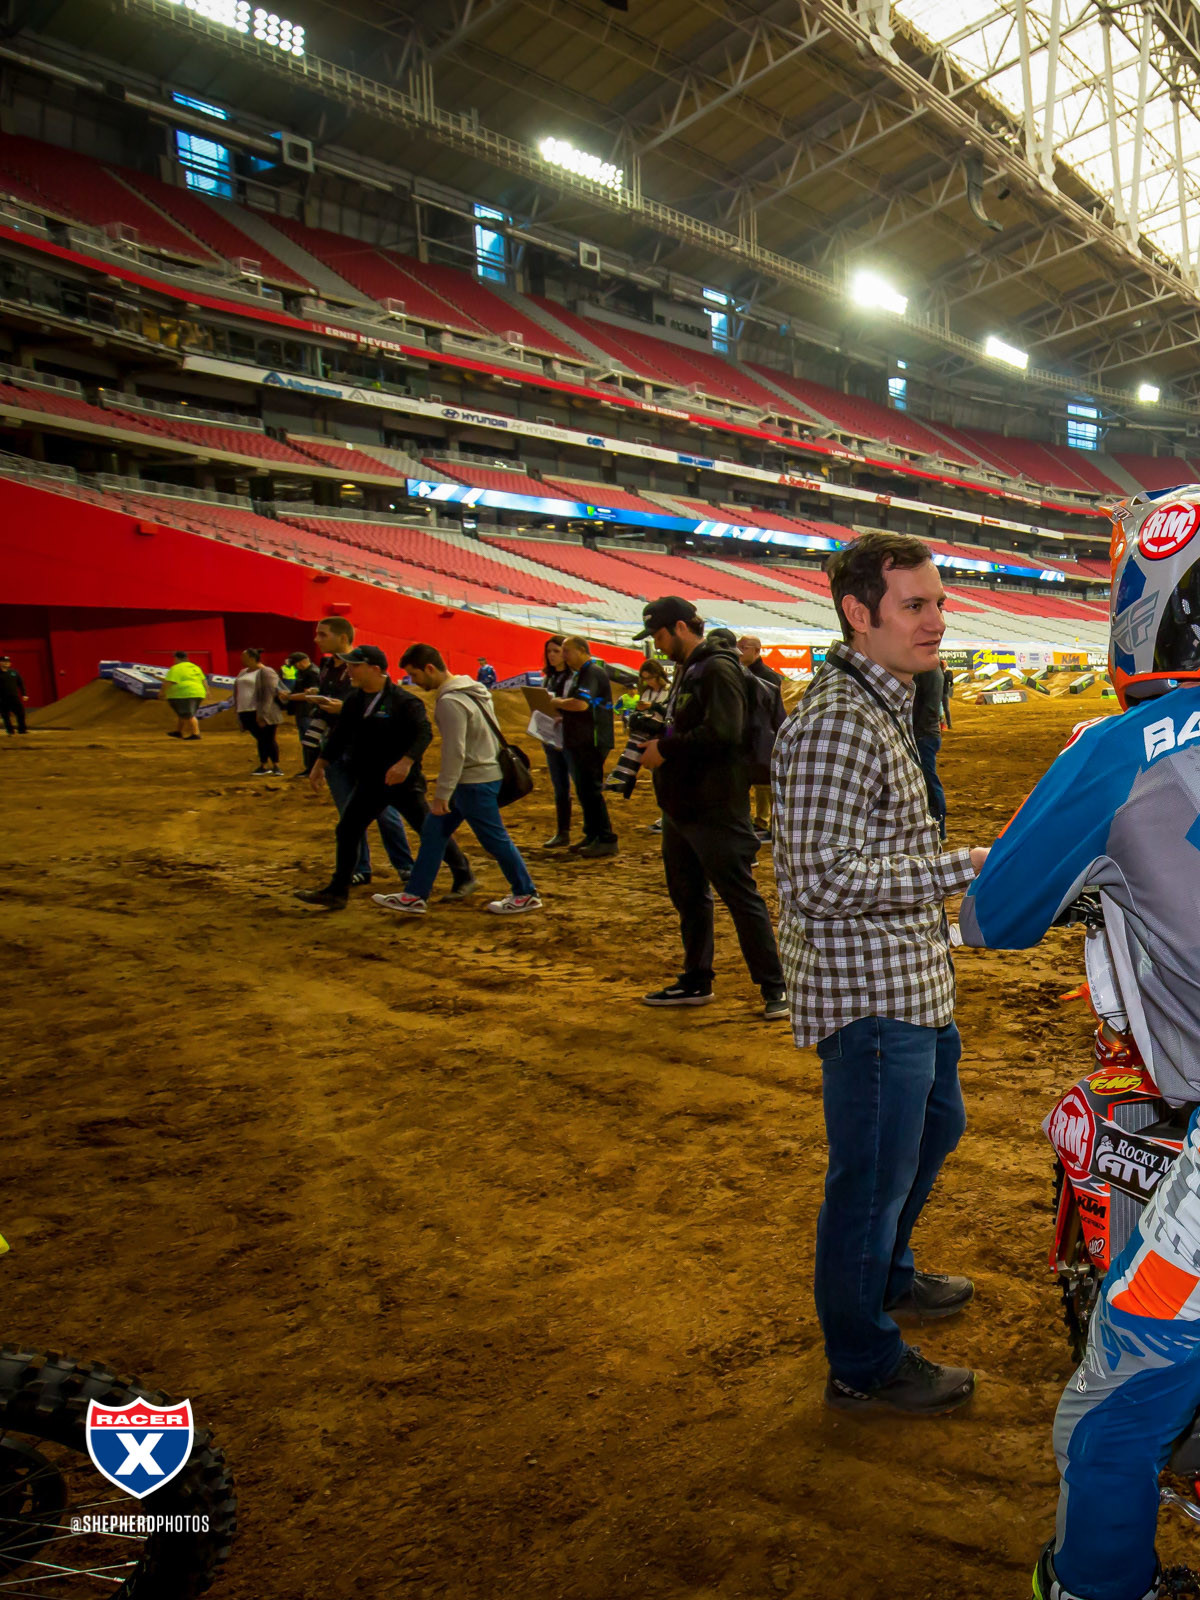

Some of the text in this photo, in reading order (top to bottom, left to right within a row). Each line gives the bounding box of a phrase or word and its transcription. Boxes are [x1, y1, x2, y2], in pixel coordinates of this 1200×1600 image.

[325, 327, 358, 342] ERNIE
[360, 335, 401, 351] NEVERS
[287, 379, 343, 399] Albertsons
[461, 412, 508, 429] HYUNDAI
[526, 426, 569, 440] HYUNDAI
[1062, 653, 1080, 664] KTM
[1090, 1075, 1143, 1093] FMF
[1115, 1138, 1160, 1168] ROCKY
[1077, 1195, 1107, 1219] KTM
